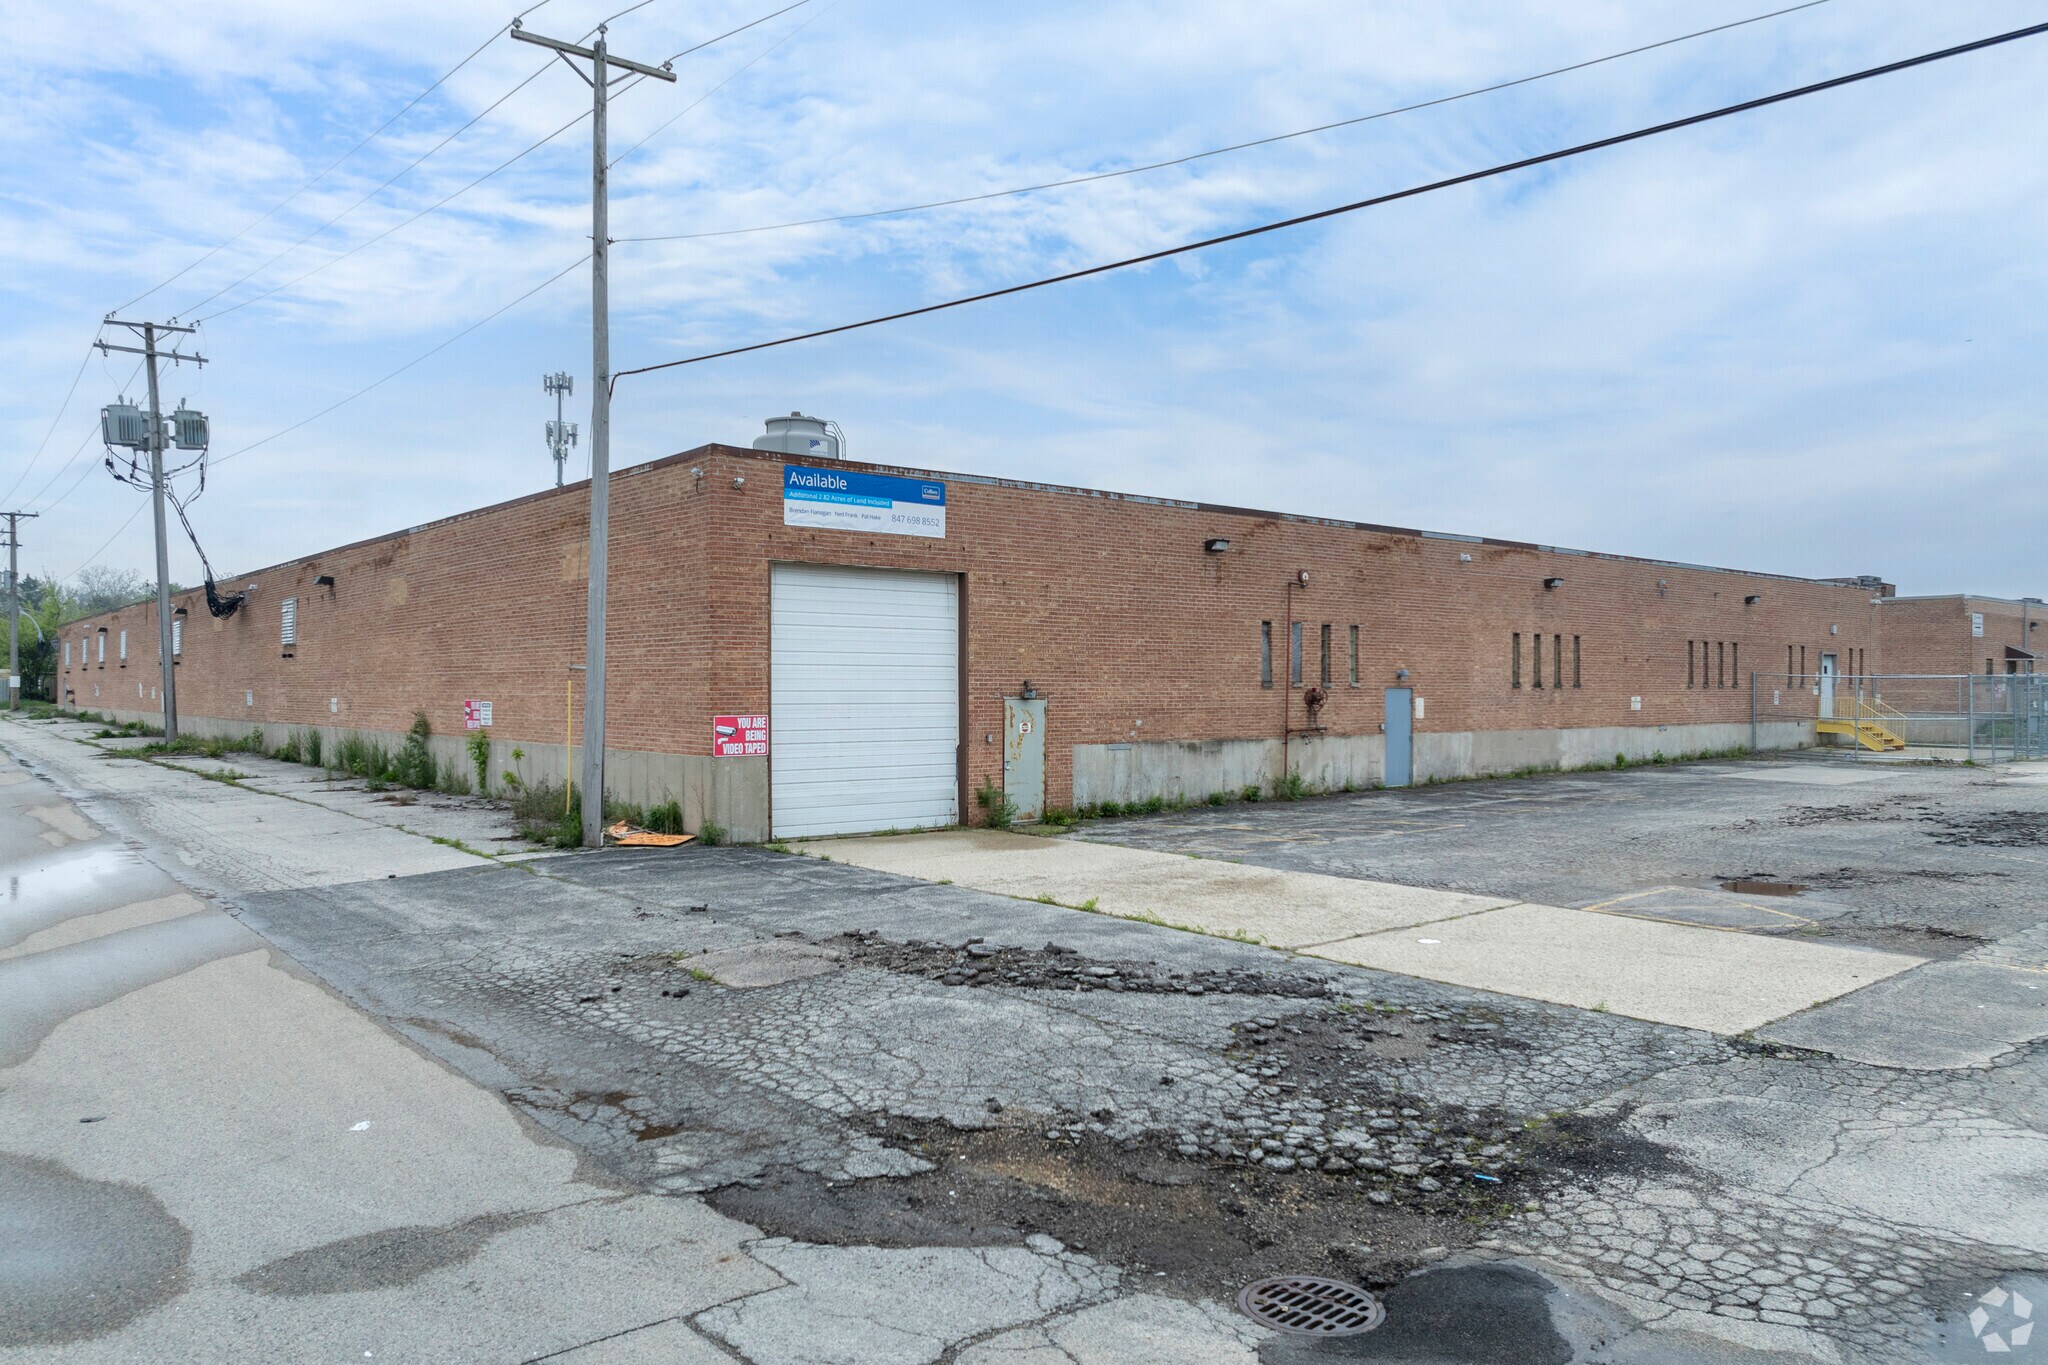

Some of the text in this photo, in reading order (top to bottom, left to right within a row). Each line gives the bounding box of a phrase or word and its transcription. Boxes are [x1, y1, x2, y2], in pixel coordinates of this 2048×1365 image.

[790, 472, 847, 490] Available
[789, 491, 818, 500] Additional
[818, 493, 830, 501] 2.82
[867, 498, 890, 507] Included
[891, 513, 940, 528] 847 698 8552
[737, 717, 766, 728] YOU ARE
[745, 730, 766, 741] BEING
[722, 742, 766, 754] VIDEO TAPED
